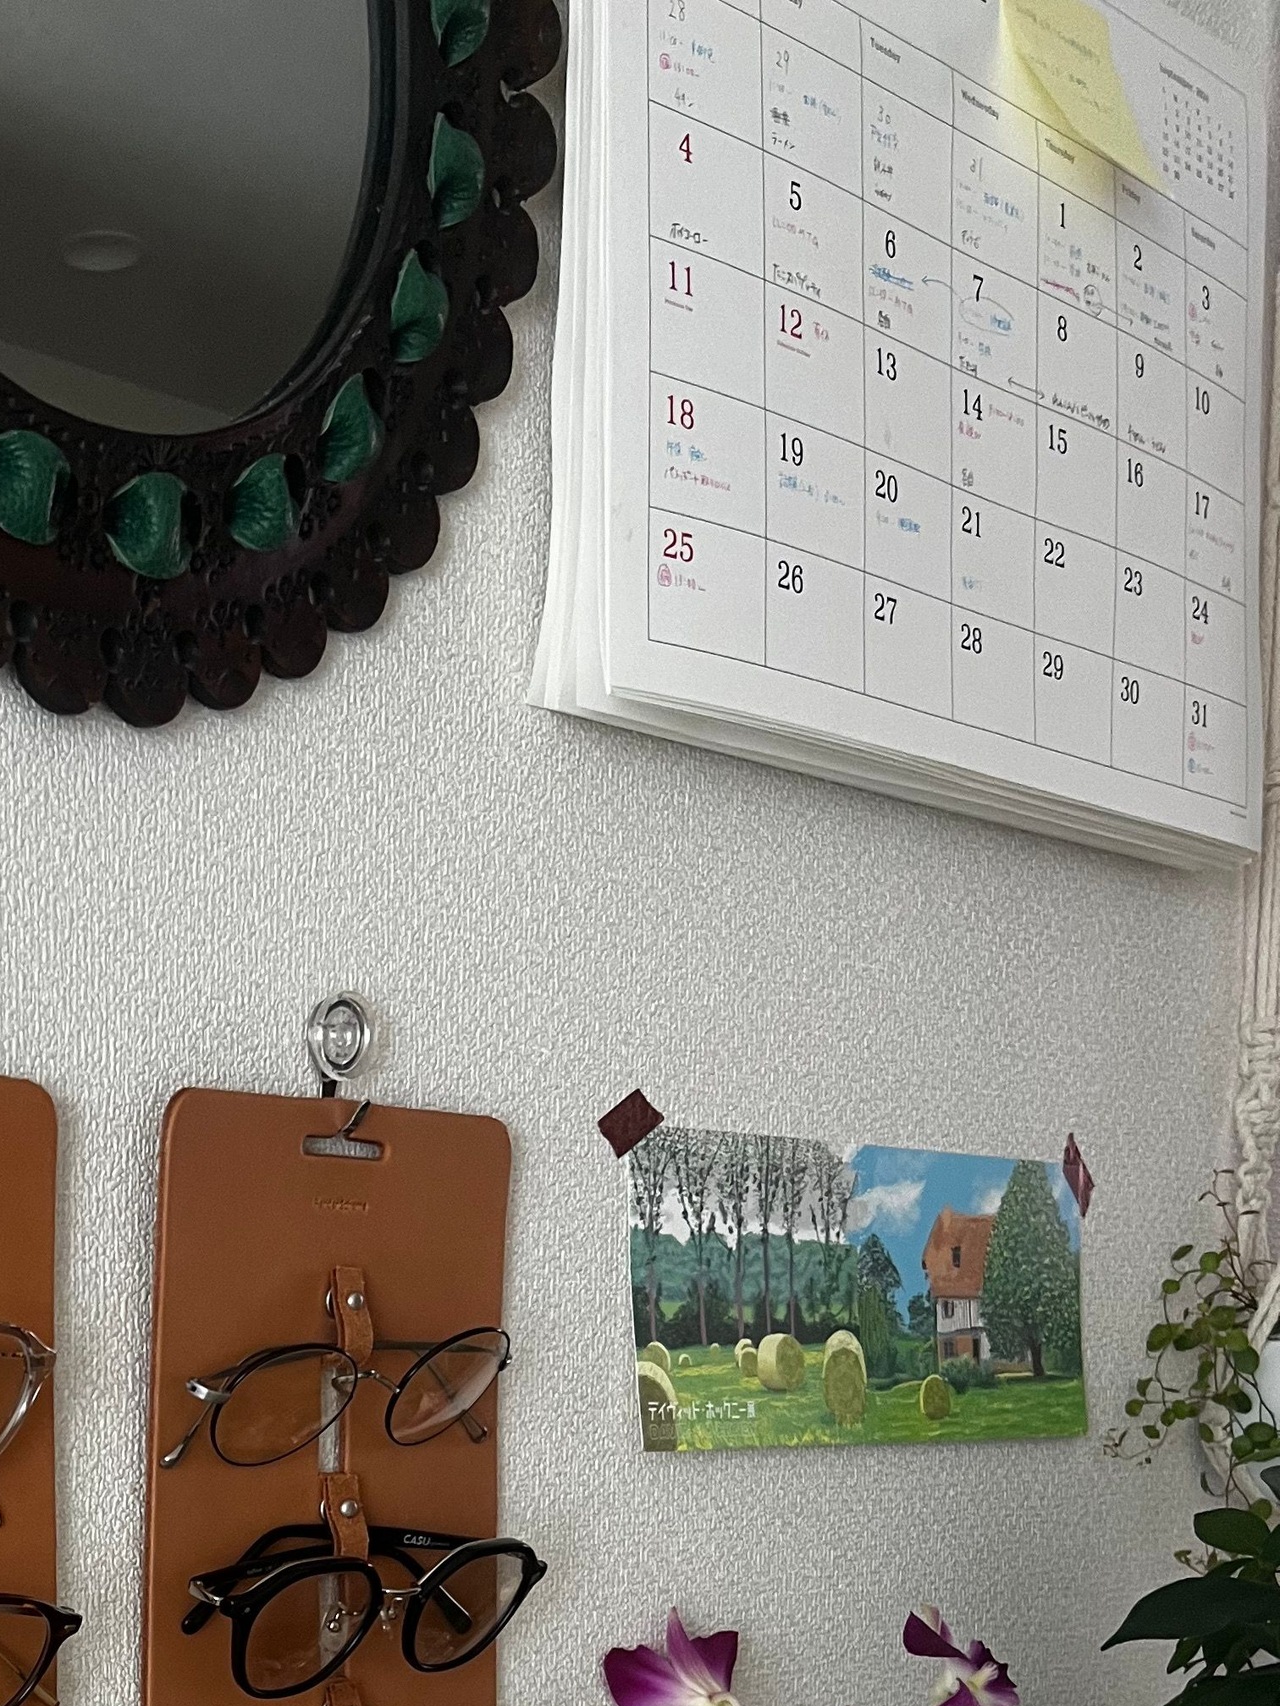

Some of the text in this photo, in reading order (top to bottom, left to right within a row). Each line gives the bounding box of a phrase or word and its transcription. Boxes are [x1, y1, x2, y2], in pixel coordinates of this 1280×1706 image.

[678, 133, 693, 164] 4
[789, 181, 802, 211] 5
[1059, 203, 1066, 229] 1
[885, 229, 896, 258] 6
[1133, 244, 1143, 271] 2
[668, 260, 693, 297] 11
[972, 274, 984, 302] 7
[1201, 285, 1211, 310] 3
[780, 304, 803, 340] 12
[1057, 315, 1067, 341] 8
[877, 347, 897, 381] 13
[1135, 353, 1144, 378] 9
[666, 394, 695, 430] 18
[963, 388, 983, 421] 14
[1195, 386, 1210, 415] 10
[780, 432, 804, 466] 19
[1048, 424, 1067, 454] 15
[874, 469, 898, 503] 20
[1126, 458, 1144, 487] 16
[1194, 491, 1210, 519] 17
[961, 505, 982, 539] 21
[663, 528, 694, 562] 25
[1043, 537, 1065, 569] 22
[777, 560, 804, 594] 26
[1123, 567, 1143, 597] 23
[874, 593, 898, 625] 27
[1191, 596, 1210, 625] 24
[960, 623, 983, 655] 28
[1042, 651, 1064, 681] 29
[1120, 676, 1140, 705] 30
[1191, 700, 1208, 728] 31
[403, 1534, 431, 1547] CASU
